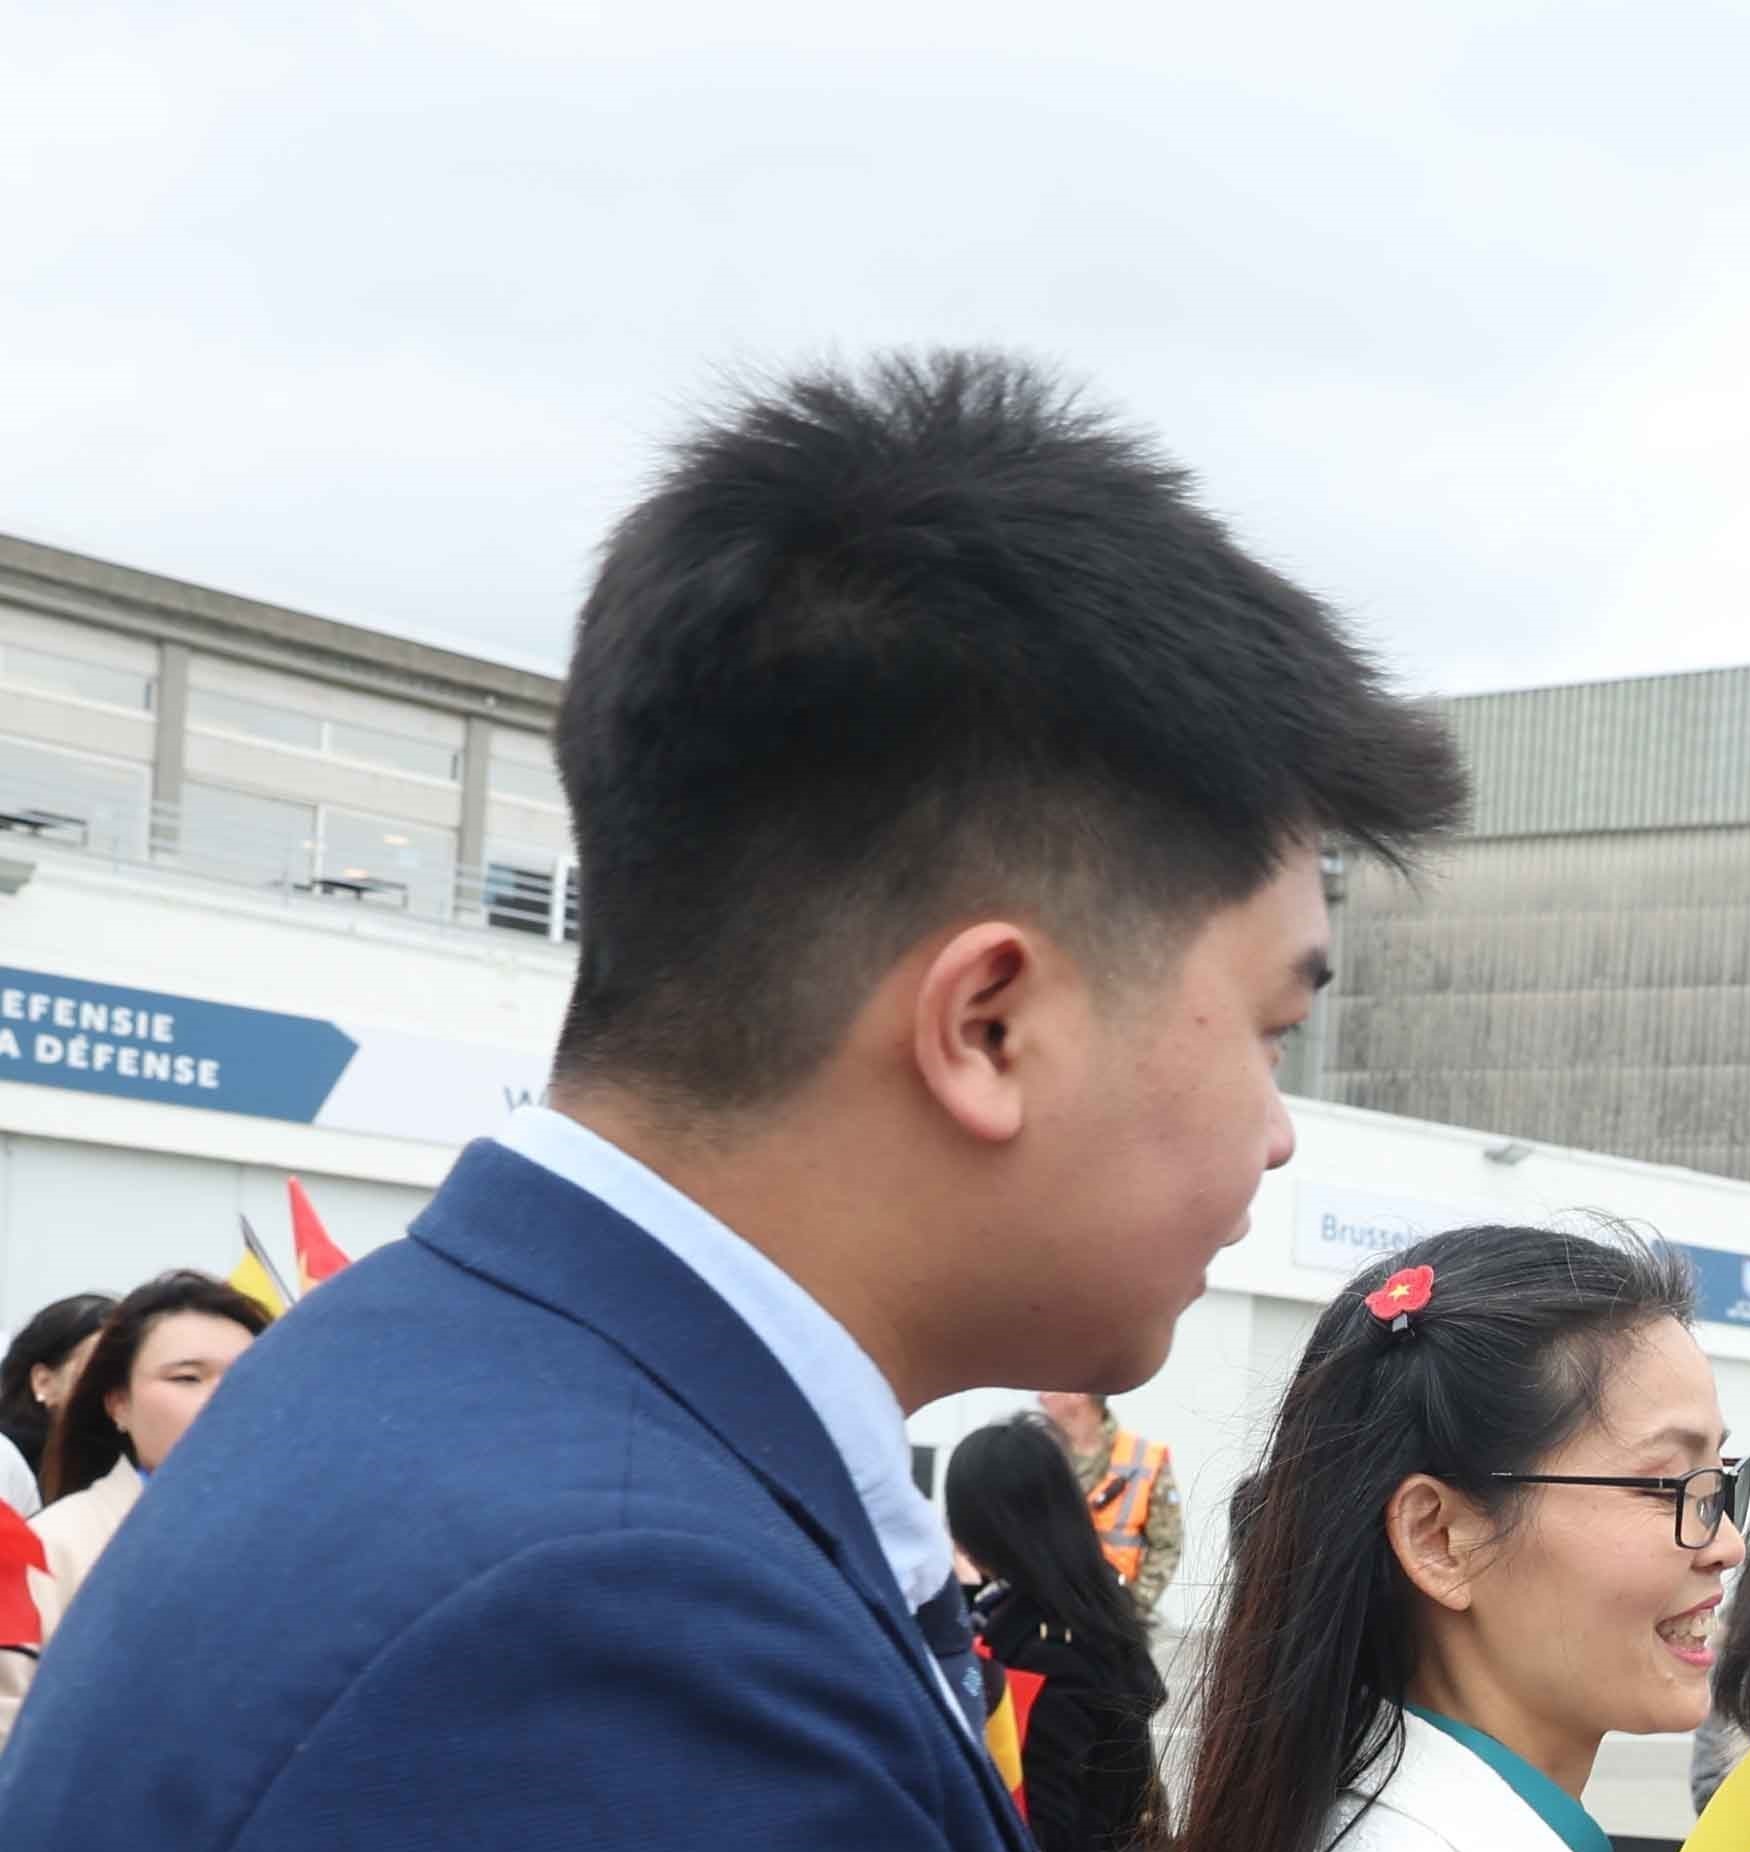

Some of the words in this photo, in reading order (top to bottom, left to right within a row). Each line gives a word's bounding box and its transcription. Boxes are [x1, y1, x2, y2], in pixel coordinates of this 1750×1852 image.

[0, 988, 176, 1043] EFENSIE
[0, 1027, 22, 1060] A
[35, 1033, 220, 1089] DÉFENSE
